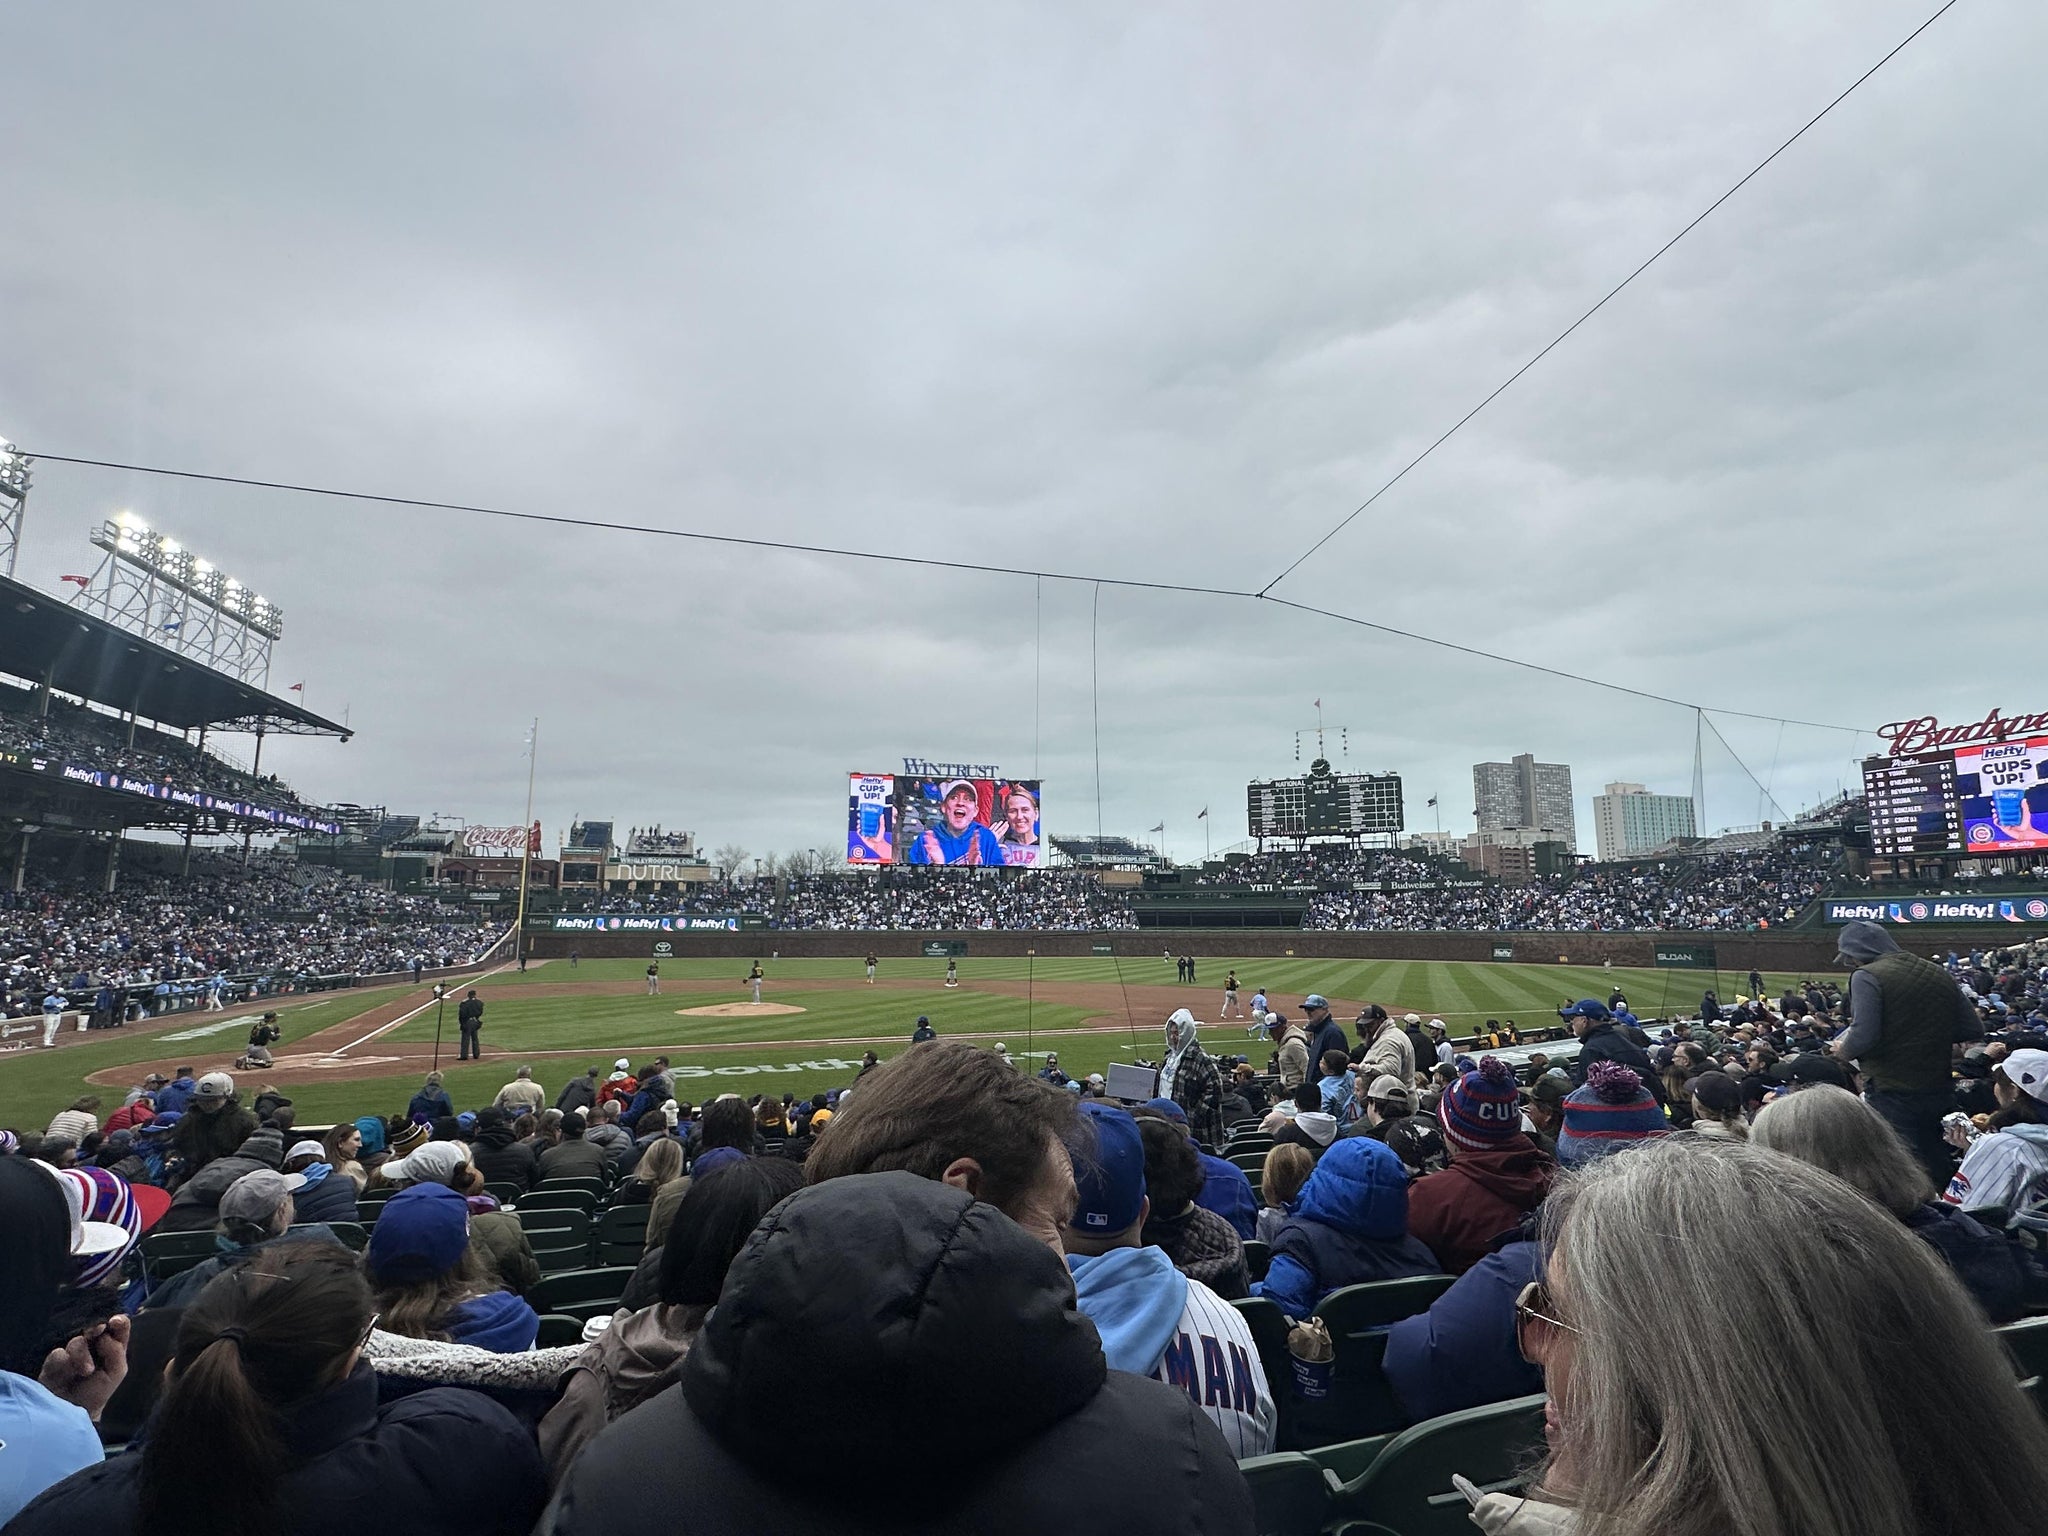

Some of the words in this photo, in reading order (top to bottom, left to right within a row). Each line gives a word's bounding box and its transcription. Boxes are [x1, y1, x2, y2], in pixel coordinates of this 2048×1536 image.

[1984, 746, 2024, 757] Hefty
[902, 757, 999, 779] WINTRUST
[1891, 758, 1920, 767] Pirates
[1981, 759, 2032, 774] CUPS
[64, 766, 95, 783] Hefty!
[1337, 776, 1370, 784] AMERICAN
[1992, 773, 2024, 786] UP!
[122, 779, 149, 795] Hefty!
[859, 784, 885, 792] CUPS
[1275, 780, 1306, 788] NATIONAL
[172, 790, 195, 804] Hefty!
[864, 792, 880, 800] UP!
[1250, 883, 1273, 891] YETI
[1391, 881, 1437, 889] Budweiser
[1453, 880, 1484, 888] Advocate
[1832, 905, 1885, 920] Hefty!
[1933, 904, 1994, 919] Hefty!
[556, 918, 594, 929] Hefty!
[623, 918, 660, 929] Hefty!
[691, 918, 726, 929] Hefty!
